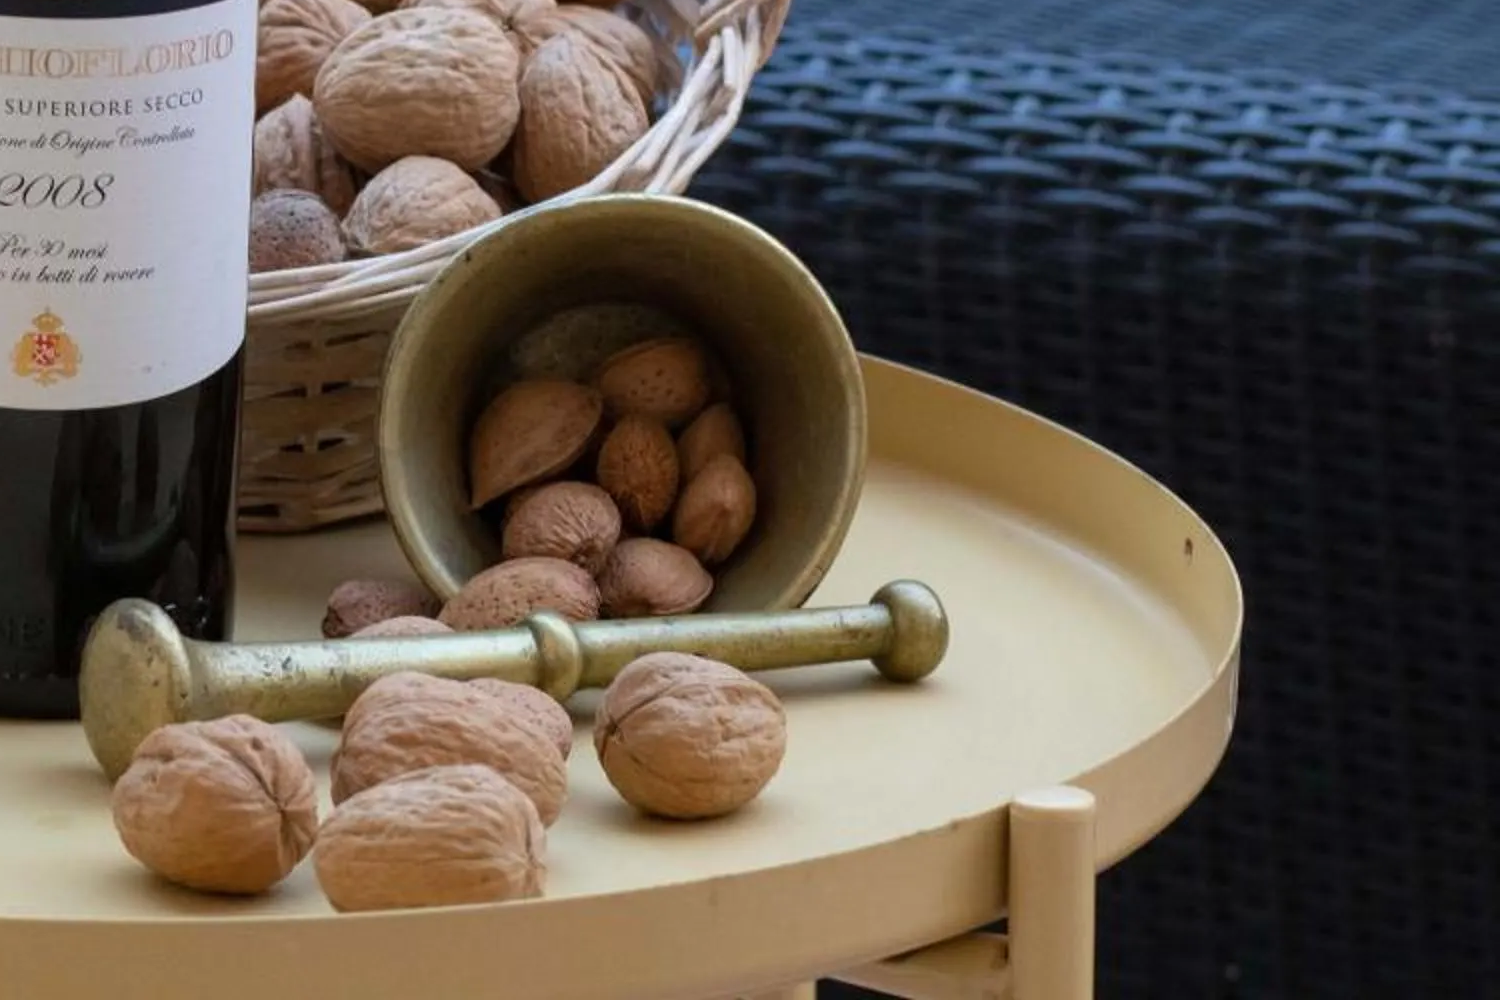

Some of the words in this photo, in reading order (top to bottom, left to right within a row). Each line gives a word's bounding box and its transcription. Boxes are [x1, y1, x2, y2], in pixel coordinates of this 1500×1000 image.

[4, 98, 134, 118] SUPERIORE
[143, 87, 204, 114] SECCO
[30, 133, 47, 150] di
[50, 130, 114, 159] Origine
[67, 243, 109, 260] mesi
[10, 267, 31, 282] in
[36, 264, 75, 283] botti
[78, 264, 100, 283] di
[103, 266, 155, 283] rovere
